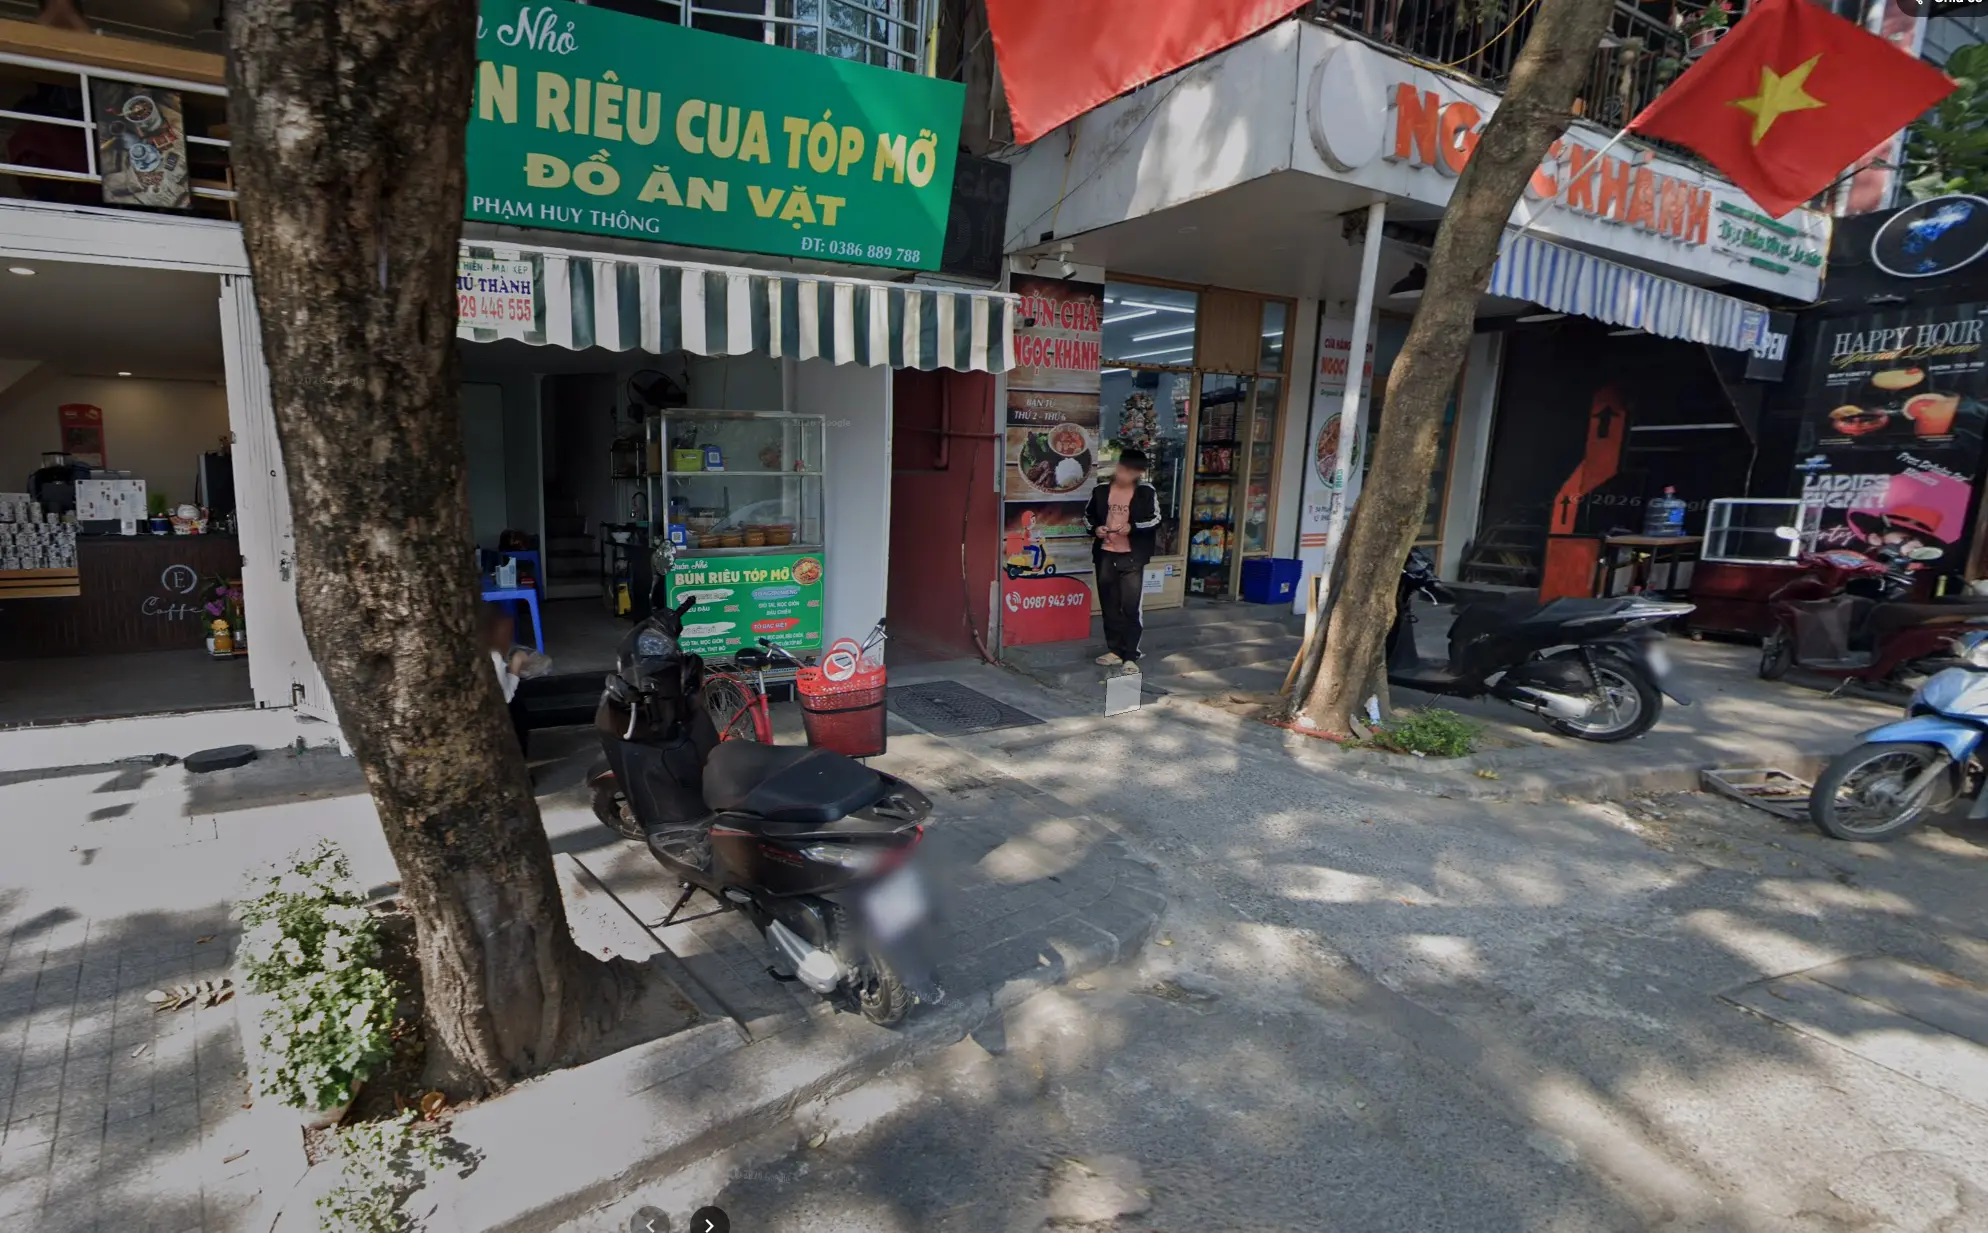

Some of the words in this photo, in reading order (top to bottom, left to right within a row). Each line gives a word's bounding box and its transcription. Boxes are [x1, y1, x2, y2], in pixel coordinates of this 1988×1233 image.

[497, 6, 579, 55] Nhỏ
[536, 70, 661, 146] RIÊU
[676, 100, 771, 165] CUA
[783, 108, 865, 177] TÓP
[872, 128, 938, 188] MỠ
[1395, 81, 1564, 199] NGC
[523, 148, 621, 197] ĐỒ
[637, 163, 730, 212] ĂN
[747, 185, 846, 230] VẶT
[472, 196, 534, 222] PHẠM
[540, 204, 582, 225] HUY
[590, 207, 661, 234] THÔNG
[801, 237, 825, 253] ĐT:
[829, 239, 863, 257] 0386
[867, 243, 893, 260] 889
[897, 245, 922, 264] 788
[478, 276, 531, 295] THÀNH
[481, 297, 504, 320] 446
[508, 298, 532, 322] 555
[1060, 295, 1098, 331] CHẢ
[1014, 335, 1051, 375] NGỌC
[1055, 334, 1099, 370] KHÁNH
[1832, 326, 1912, 357] HAPPY
[1915, 319, 1984, 347] HOUR
[675, 570, 705, 586] BÚN
[708, 569, 740, 584] RIÊU
[743, 568, 768, 582] TÓP
[1023, 595, 1046, 609] 0987
[1048, 594, 1065, 607] 942
[1067, 593, 1084, 606] 907
